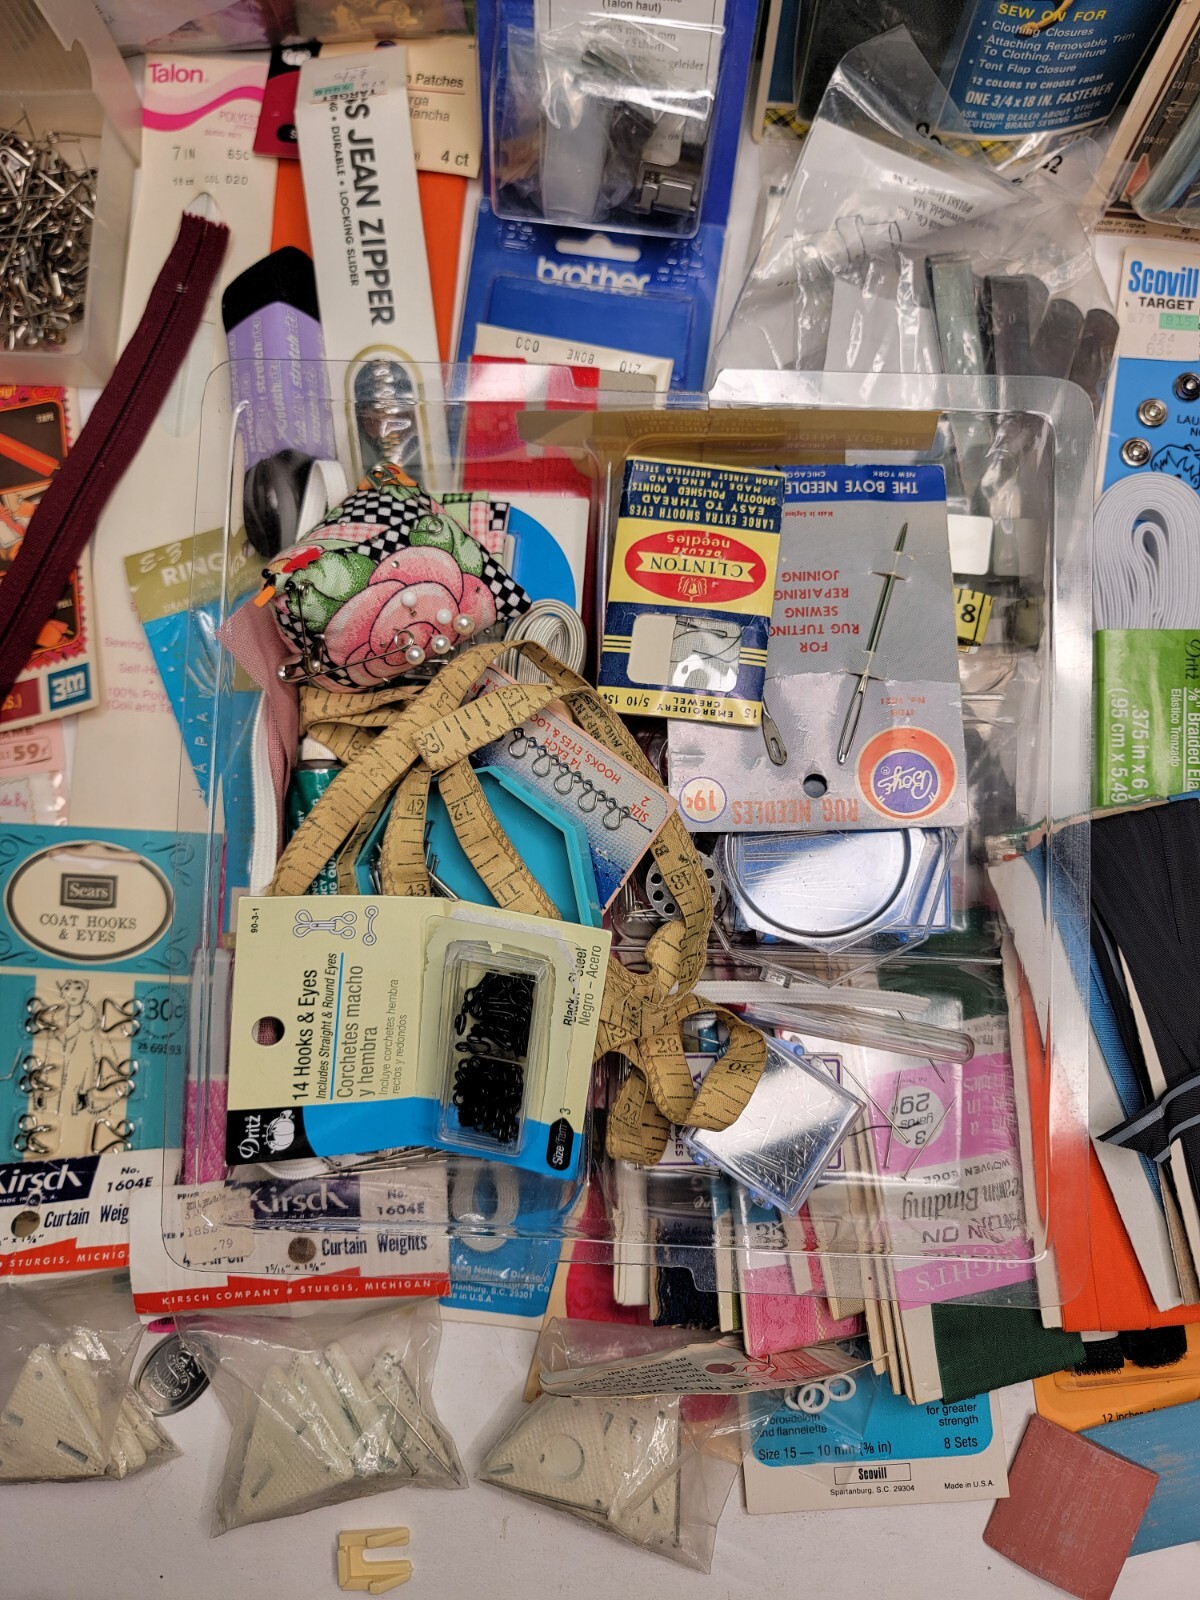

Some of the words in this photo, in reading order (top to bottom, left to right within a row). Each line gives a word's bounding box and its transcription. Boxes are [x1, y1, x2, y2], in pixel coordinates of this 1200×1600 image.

[997, 3, 1035, 19] SEW
[1073, 10, 1107, 22] FOR
[1045, 27, 1095, 37] Closures
[986, 34, 1041, 51] Attaching
[1046, 39, 1108, 50] Removable
[1113, 32, 1136, 43] Trim
[984, 45, 997, 56] To
[1002, 48, 1052, 63] Clothing,
[1057, 47, 1107, 61] Furniture
[148, 63, 204, 84] Talon
[980, 58, 1003, 71] Tent
[1007, 63, 1031, 75] Flap
[1035, 63, 1077, 74] Closure
[415, 73, 465, 88] Patches
[972, 76, 982, 86] 12
[985, 78, 1022, 89] COLORS
[1025, 80, 1037, 89] TO
[1040, 78, 1075, 89] CHOOSE
[1078, 73, 1104, 85] FROM
[965, 91, 992, 105] ONE
[1056, 82, 1114, 105] FASTENER
[981, 111, 1004, 121] YOUR
[331, 125, 346, 177] DURABLE
[440, 150, 449, 164] 4
[454, 153, 470, 167] ct
[347, 128, 382, 208] JEAN
[338, 190, 355, 245] LOCKING
[346, 247, 360, 287] SLIDER
[358, 218, 397, 327] ZIPPER
[537, 254, 652, 297] brother
[1127, 260, 1200, 300] Scovill
[1138, 296, 1195, 311] TARGET
[566, 348, 596, 365] BONE
[36, 412, 55, 425] TAPE
[634, 463, 660, 474] STEEL
[665, 467, 712, 481] SHEFFIELD
[872, 470, 895, 478] YORK
[898, 470, 916, 478] NEW
[649, 474, 705, 488] ENGLAND
[711, 479, 724, 490] IN
[719, 473, 749, 485] FINEST
[755, 477, 779, 488] FROM
[632, 481, 668, 494] POINTS
[678, 487, 726, 501] POLISHED
[729, 483, 761, 495] MADE
[785, 480, 838, 495] NEEDLE
[845, 480, 885, 495] BOYE
[892, 481, 919, 495] THE
[641, 494, 698, 509] THREAD
[705, 500, 724, 511] TO
[736, 492, 778, 506] SMOOTH
[629, 503, 654, 518] EYES
[659, 508, 701, 522] SMOOTH
[730, 502, 766, 516] EASY
[705, 512, 737, 526] EXTRA
[742, 517, 775, 531] LARGE
[666, 533, 730, 549] needles
[672, 546, 723, 558] DELUXE
[649, 555, 744, 579] CLINTON
[781, 569, 840, 582] JOINING
[773, 587, 849, 601] REPAIRING
[784, 605, 839, 618] SEWING
[960, 603, 977, 623] 8
[830, 623, 860, 635] RUG
[799, 641, 829, 653] FOR
[626, 692, 650, 706] 5/10
[672, 696, 721, 709] CREWEL
[1110, 687, 1128, 720] (.95
[1170, 688, 1182, 724] Elástico
[656, 702, 734, 718] EMBROIDERY
[744, 707, 757, 718] 15
[1131, 703, 1150, 740] .375
[1110, 723, 1126, 748] cm
[543, 736, 569, 760] EACH
[570, 757, 581, 770] 14
[1131, 745, 1149, 760] in
[1170, 726, 1182, 767] Trenzado
[561, 734, 584, 756] EYES
[584, 753, 622, 785] HOOKS,
[1110, 752, 1126, 764] x
[1131, 764, 1145, 775] x
[1131, 777, 1150, 791] 6
[406, 798, 426, 816] 42
[640, 796, 652, 808] 2
[731, 799, 812, 825] NEEDLES
[822, 799, 859, 823] RUG
[68, 882, 111, 900] Sears
[39, 913, 80, 928] COAT
[86, 914, 138, 930] HOOKS
[250, 907, 260, 934] 90-3-1
[58, 927, 70, 941] &
[76, 928, 117, 943] EYES
[325, 952, 339, 976] Eyes
[585, 944, 602, 980] Acero
[297, 969, 321, 1007] Eyes
[321, 977, 336, 1010] Round
[344, 965, 364, 1018] macho
[386, 978, 399, 1016] hembra
[296, 1011, 315, 1024] &
[321, 1011, 333, 1020] &
[577, 992, 596, 1027] Negro
[318, 1019, 334, 1058] Straight
[383, 1016, 396, 1062] corchetes
[395, 1013, 408, 1057] redondos
[293, 1027, 314, 1078] Hooks
[654, 1037, 680, 1054] 28
[336, 1022, 358, 1099] Corchetes
[359, 1026, 378, 1086] hembra
[315, 1061, 329, 1100] Includes
[378, 1060, 396, 1096] Incluye
[392, 1066, 404, 1095] rectos
[292, 1080, 310, 1101] 14
[358, 1088, 376, 1099] y
[559, 1107, 572, 1115] 3
[238, 1114, 262, 1159] Dritz
[914, 1130, 927, 1146] 3
[552, 1143, 567, 1166] Size
[120, 1165, 141, 1178] No.
[922, 1169, 960, 1185] EDGE
[106, 1176, 154, 1193] 1604E
[387, 1187, 408, 1199] No.
[902, 1187, 979, 1221] Binding
[43, 1205, 90, 1228] Curtain
[99, 1202, 129, 1227] Weig
[921, 1226, 959, 1244] ON
[321, 1237, 368, 1257] Curtain
[376, 1234, 428, 1256] Weights
[9, 1256, 74, 1272] STURGIS,
[161, 1292, 210, 1306] KIRSCH
[216, 1287, 280, 1302] COMPANY
[299, 1280, 359, 1298] STURGIS,
[364, 1279, 431, 1292] MICHIGAN
[925, 1405, 939, 1416] for
[941, 1403, 977, 1419] greater
[938, 1414, 979, 1428] strength
[943, 1437, 951, 1449] 8
[954, 1436, 978, 1449] Sets
[758, 1448, 781, 1462] Size
[783, 1447, 797, 1460] 15
[818, 1446, 832, 1458] 10
[877, 1440, 893, 1456] in)
[857, 1466, 888, 1481] Scovill
[829, 1486, 875, 1498] Spartanburg,
[876, 1484, 892, 1495] S.C.
[893, 1483, 915, 1493] 29304
[943, 1481, 964, 1491] Made
[965, 1481, 971, 1490] in
[973, 1478, 996, 1488] U.S.A.
